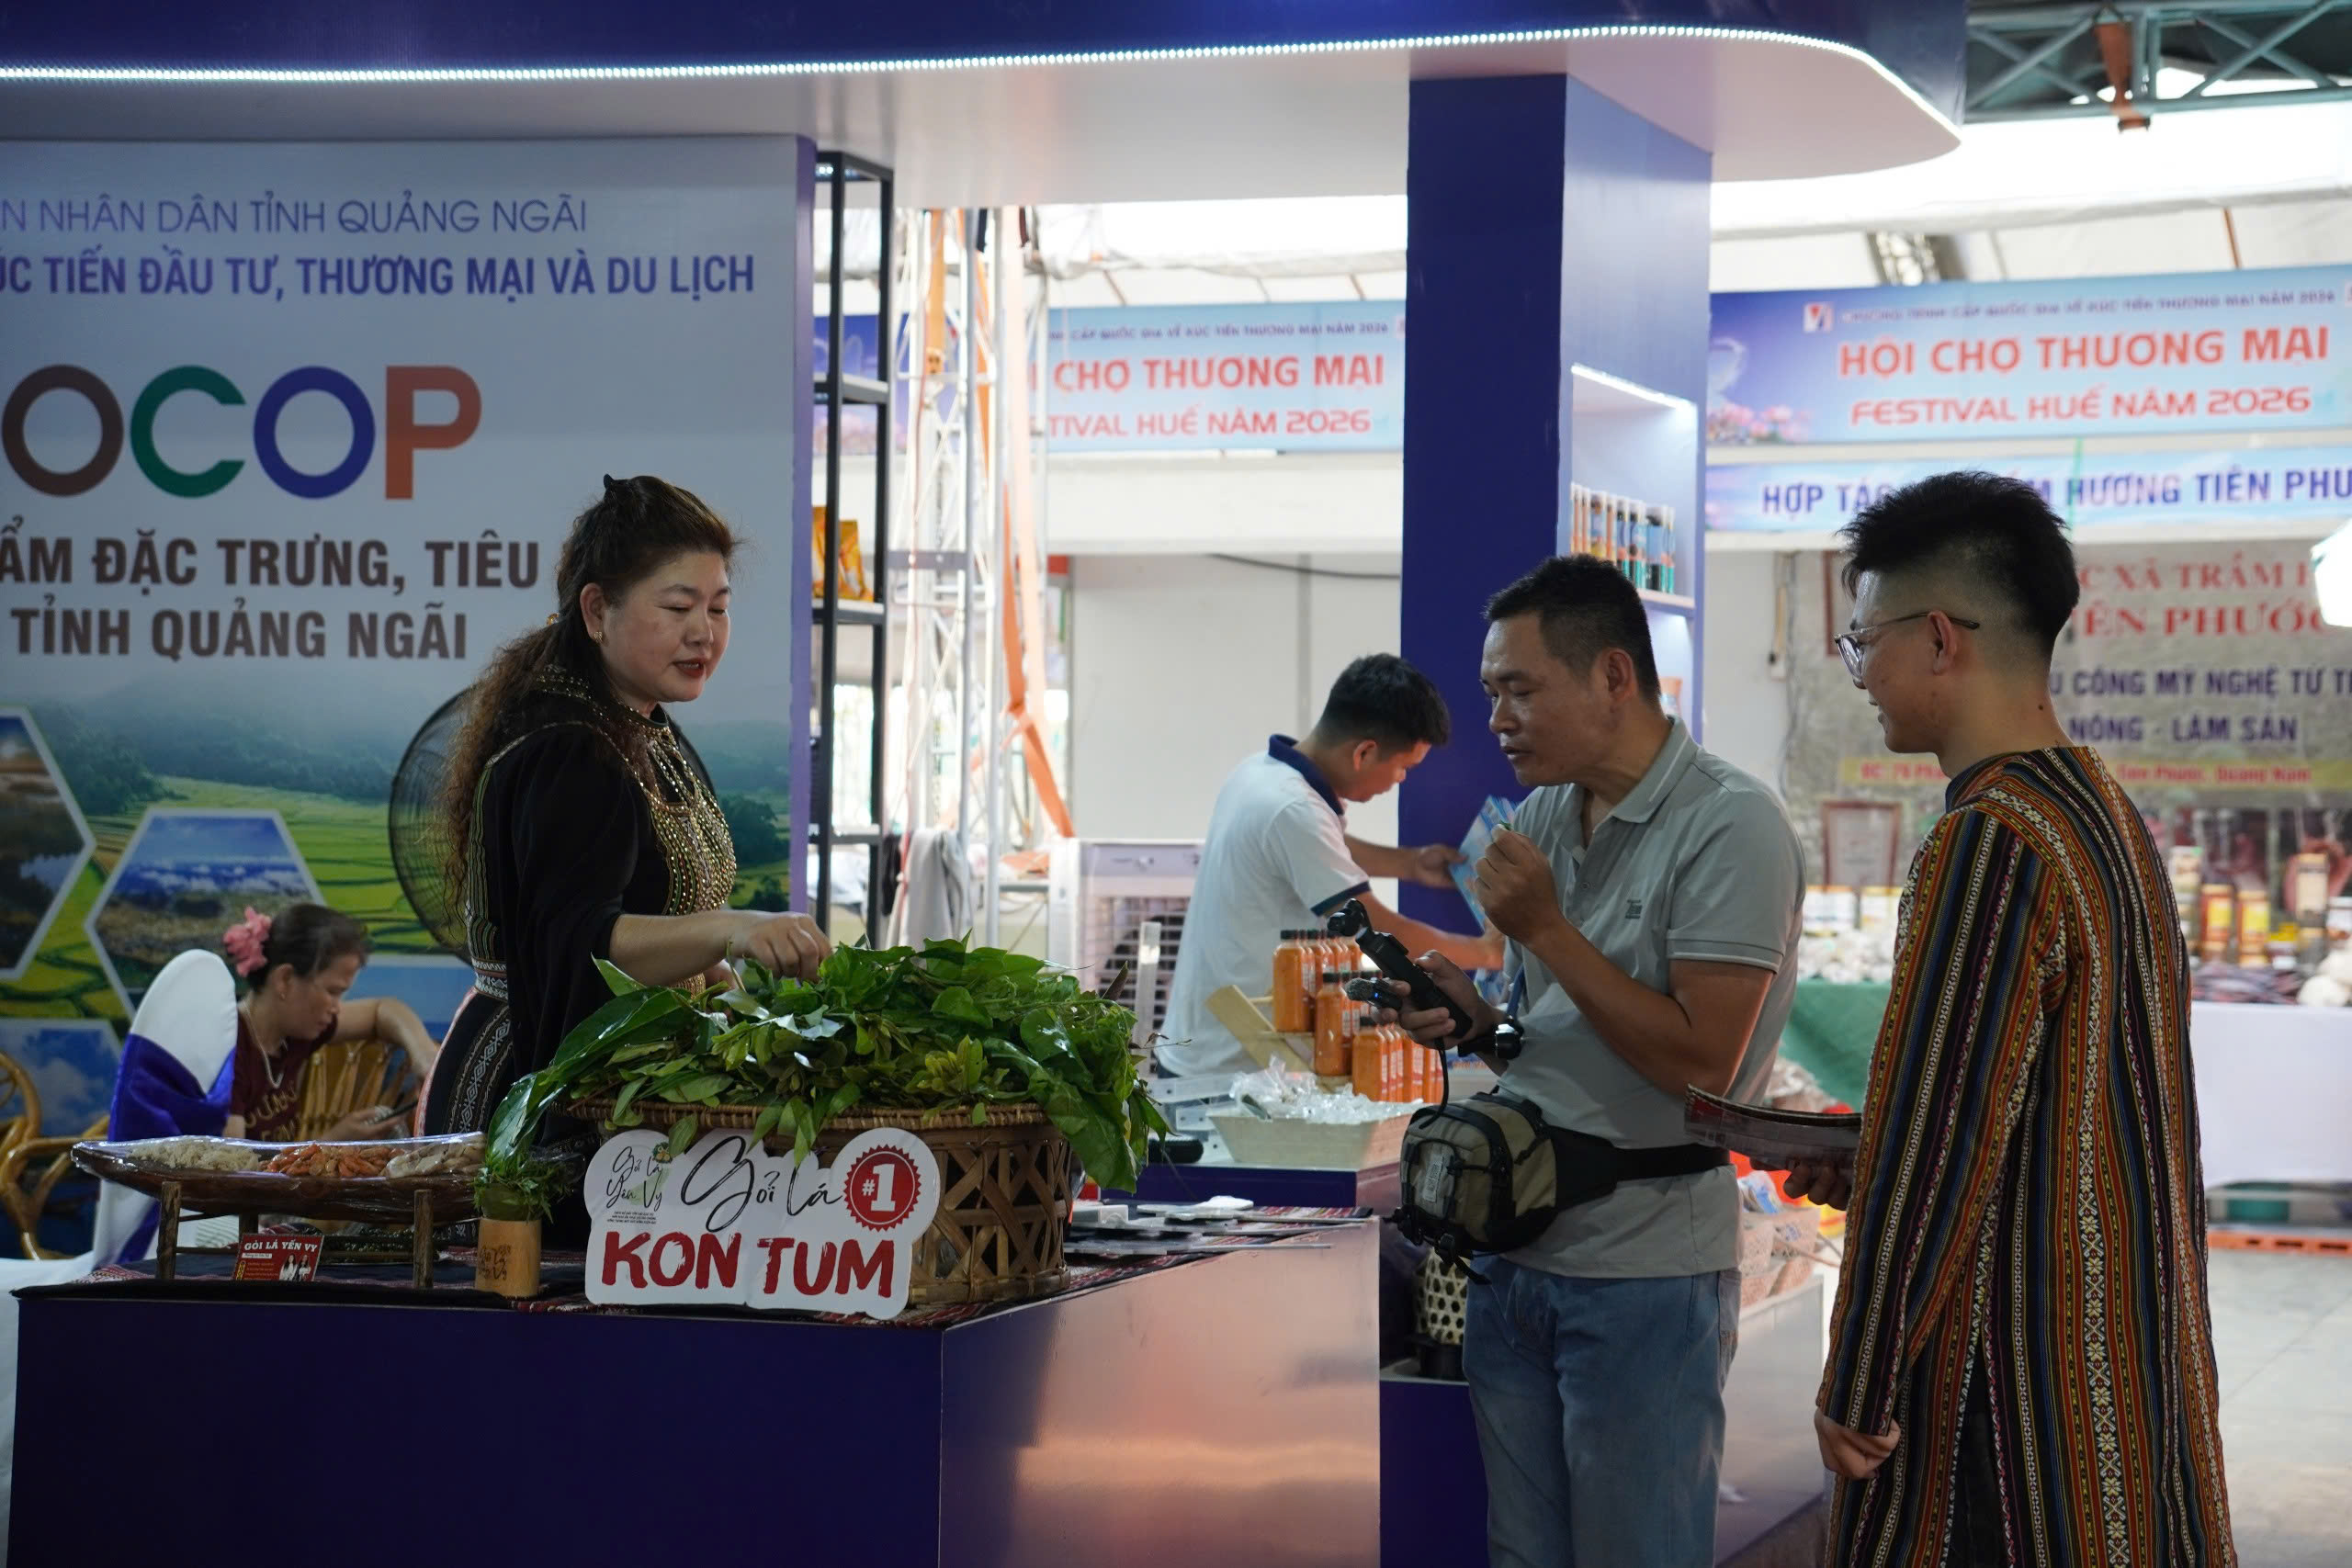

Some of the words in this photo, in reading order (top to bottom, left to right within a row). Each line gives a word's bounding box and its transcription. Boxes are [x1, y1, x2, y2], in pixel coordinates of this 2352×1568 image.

[40, 193, 145, 233] NHÂN
[157, 193, 238, 233] DÂN
[249, 190, 325, 233] TỈNH
[337, 189, 480, 234] QUẢNG
[493, 193, 586, 233] NGÃI
[0, 246, 32, 295] C
[43, 243, 126, 295] TIẾN
[139, 243, 213, 295] ĐẦU
[224, 255, 284, 302] TƯ,
[296, 254, 454, 296] THƯƠNG
[466, 256, 535, 303] MẠI
[547, 248, 595, 295] VÀ
[607, 256, 657, 294] DU
[670, 254, 754, 301] LỊCH
[1207, 406, 1277, 437] NĂM
[1285, 410, 1372, 434] 2026
[1850, 397, 2017, 426] FESTIVAL
[2112, 387, 2197, 418] NĂM
[2207, 387, 2312, 415] 2026
[3, 364, 482, 502] OCOP
[1762, 479, 1824, 520] HỢP
[2196, 462, 2271, 502] TIÊN
[92, 527, 198, 596] ĐẶC
[217, 532, 405, 596] TRƯNG,
[424, 528, 539, 589] TIÊU
[10, 592, 130, 656] TỈNH
[152, 596, 326, 662] QUẢNG
[347, 601, 467, 660] NGÃI
[2073, 599, 2147, 637] ÊN
[2073, 662, 2147, 696] CÔNG
[2334, 665, 2352, 694] T
[2070, 711, 2143, 742] NÔNG
[2172, 710, 2232, 741] LÂM
[681, 1135, 775, 1233] Gỏi
[862, 1163, 899, 1213] #1
[244, 1239, 263, 1251] GỎI
[266, 1238, 278, 1250] LÁ
[304, 1243, 318, 1253] VY
[601, 1231, 741, 1290] KON
[757, 1236, 896, 1299] TUM
